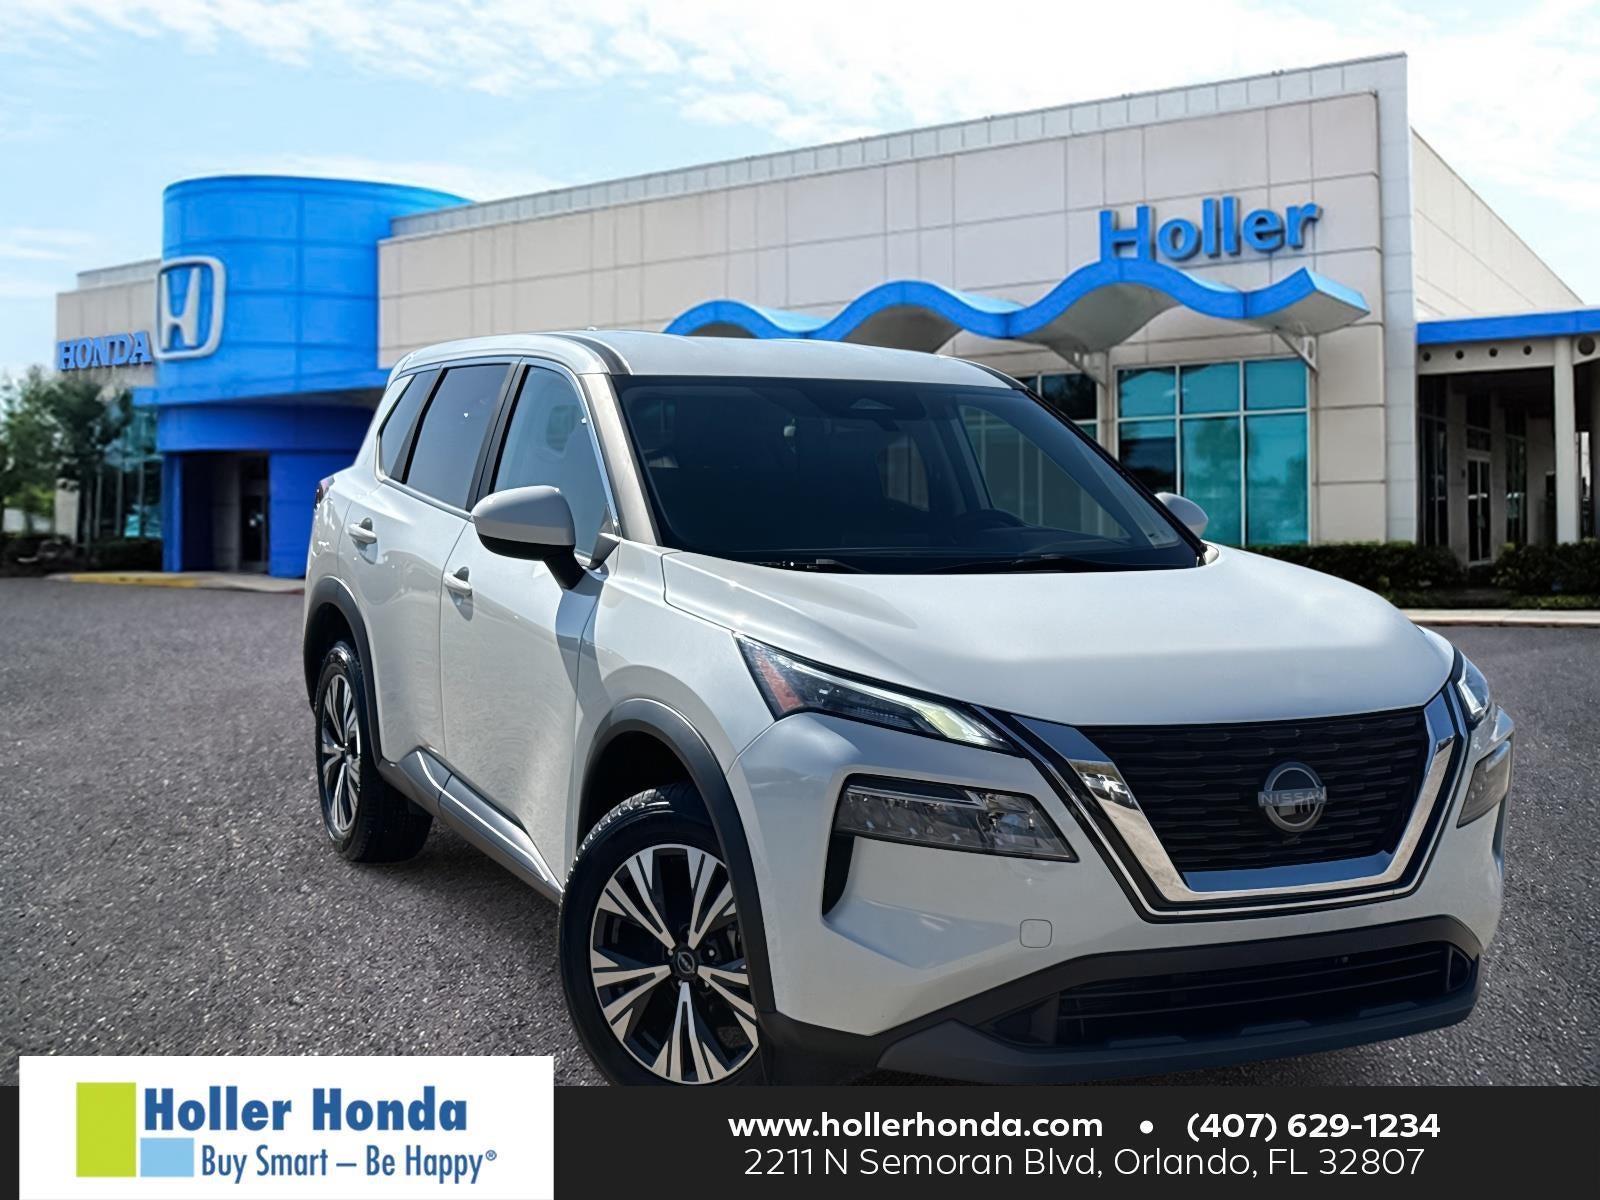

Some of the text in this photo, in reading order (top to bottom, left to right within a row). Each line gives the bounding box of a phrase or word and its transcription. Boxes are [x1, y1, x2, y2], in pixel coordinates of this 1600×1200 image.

[1099, 195, 1320, 262] Holler
[58, 331, 152, 370] HONDA
[1260, 787, 1327, 805] NISSAN
